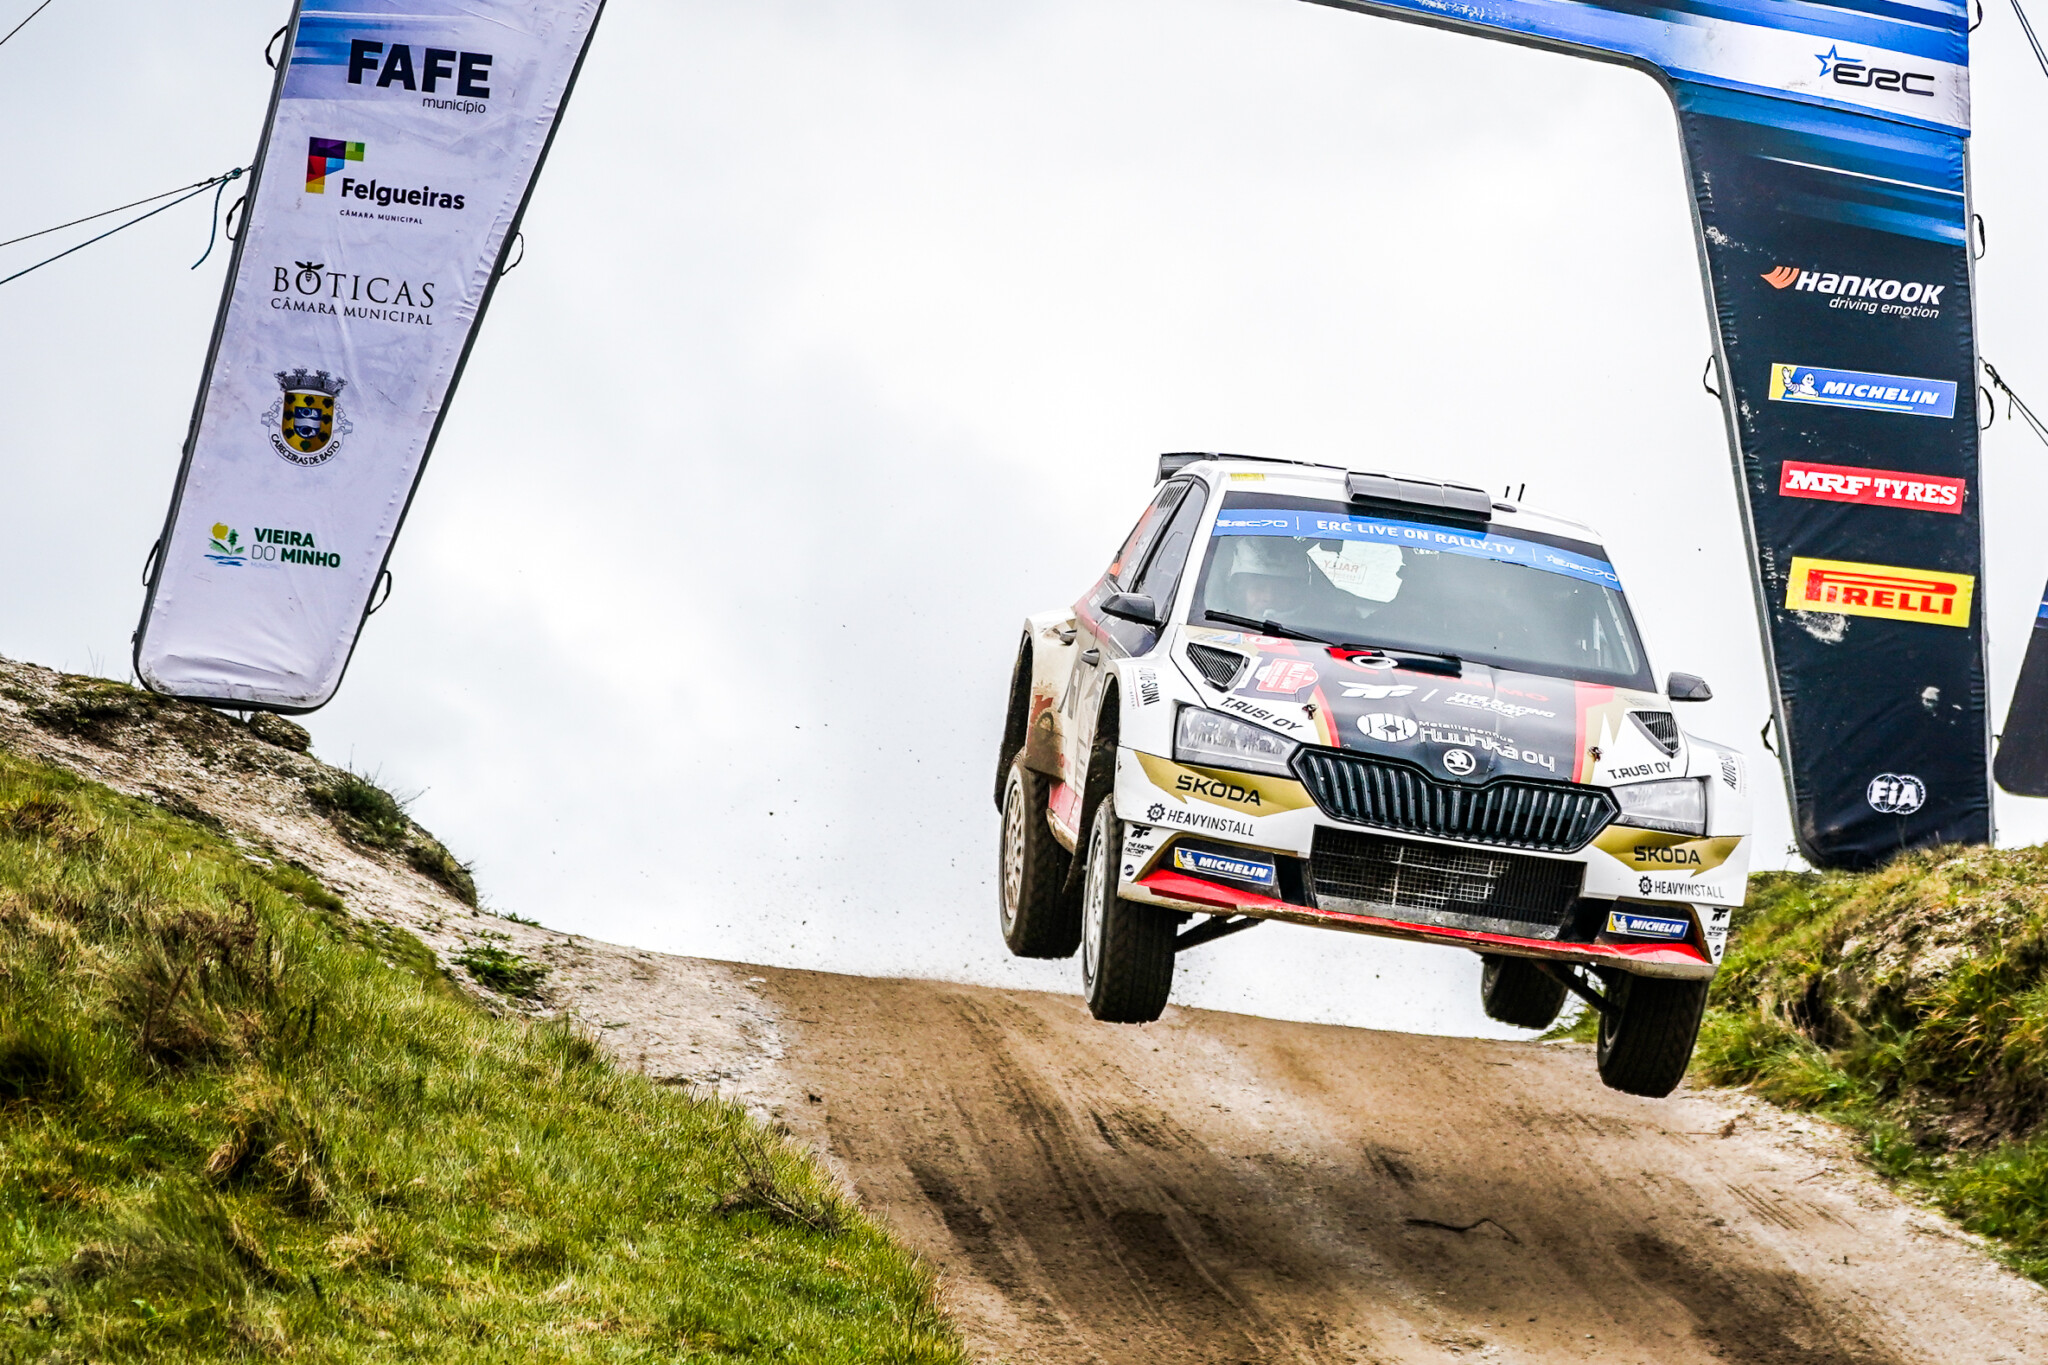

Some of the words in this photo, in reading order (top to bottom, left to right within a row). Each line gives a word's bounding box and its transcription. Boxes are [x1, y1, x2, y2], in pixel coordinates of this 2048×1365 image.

[347, 39, 493, 99] FAFE
[422, 97, 487, 115] município
[341, 177, 466, 210] Felgueiras
[339, 209, 375, 220] CÂMARA
[377, 213, 424, 225] MUNICIPAL
[272, 264, 435, 309] BOTICAS
[270, 297, 338, 317] CÂMARA
[343, 306, 434, 327] MUNICIPAL
[1828, 296, 1879, 316] driving
[1880, 301, 1940, 319] emotion
[1823, 380, 1941, 406] MICHELIN
[271, 433, 309, 465] CABECEIRAS
[308, 455, 320, 465] DE
[319, 440, 341, 462] BASTO
[1785, 469, 1872, 496] MRF
[1873, 477, 1959, 506] TYRES
[254, 527, 316, 549] VIEIRA
[1316, 519, 1353, 533] ERC
[1357, 523, 1399, 538] LIVE
[1403, 528, 1430, 541] ON
[1435, 532, 1516, 555] RALLY.TV
[251, 544, 276, 561] DO
[280, 547, 341, 569] MINHO
[1804, 568, 1958, 615] PIRELLI
[1220, 696, 1272, 722] T.RUSI
[1273, 717, 1304, 731] OY
[1608, 763, 1654, 780] T.RUSI
[1655, 761, 1672, 774] OY
[1166, 809, 1255, 837] HEAVYINSTALL
[1197, 856, 1269, 879] MICHELIN
[1654, 880, 1725, 899] HEAVYINSTALL
[1629, 919, 1685, 934] MICHELIN
